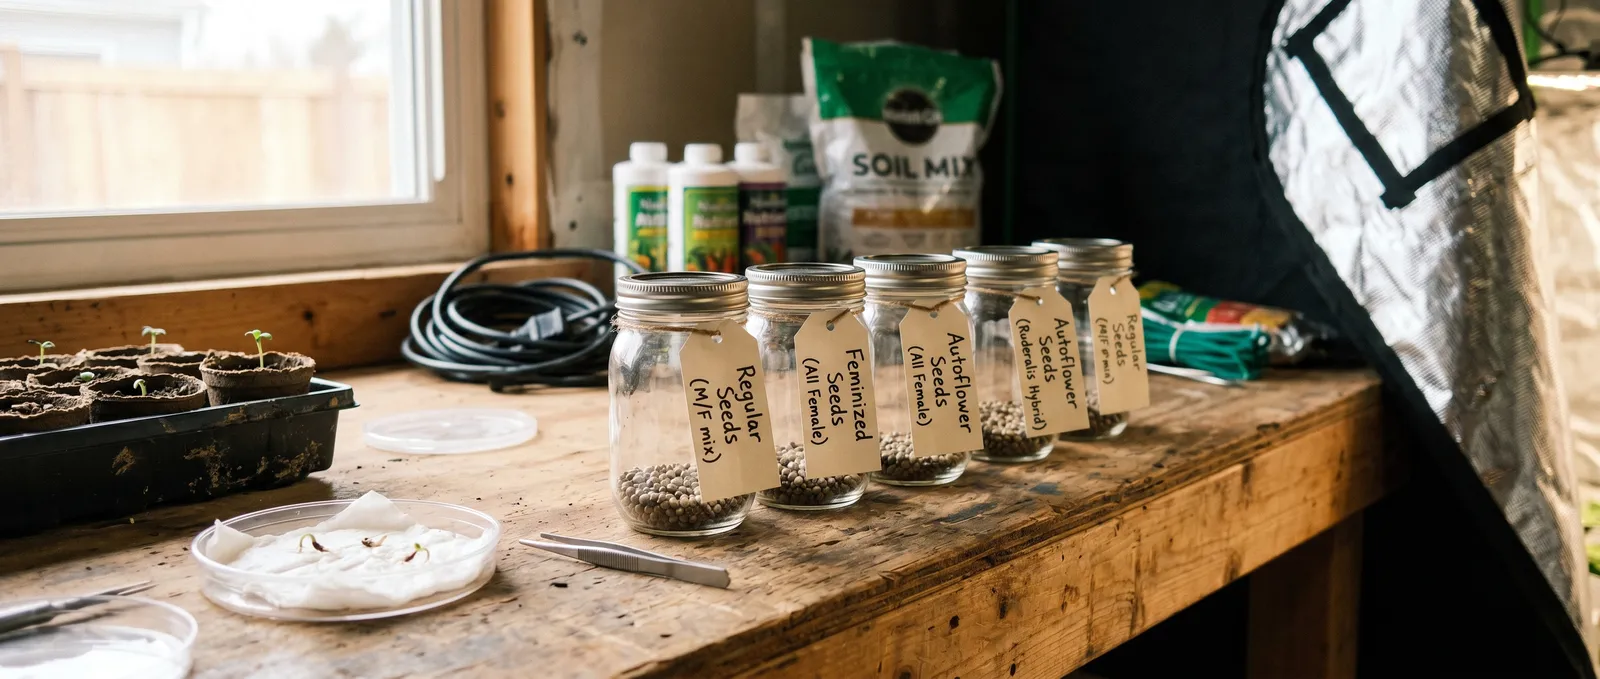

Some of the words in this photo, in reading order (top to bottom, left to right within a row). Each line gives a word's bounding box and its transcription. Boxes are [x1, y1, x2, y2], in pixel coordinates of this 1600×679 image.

[853, 153, 917, 179] SOIL
[924, 157, 976, 178] MIX
[907, 345, 924, 368] (All
[1016, 318, 1038, 380] (Ruderalis
[1039, 335, 1058, 383] Seeds
[1054, 318, 1077, 410] Autoflower
[1112, 323, 1128, 368] Seeds
[1125, 313, 1142, 371] Regular
[802, 358, 820, 384] (All
[846, 348, 873, 442] Feminized
[930, 356, 951, 408] Seeds
[947, 332, 971, 433] Autoflower
[690, 378, 713, 421] (M/F
[717, 386, 741, 445] Seeds
[735, 365, 763, 443] Regular
[807, 389, 829, 446] Female)
[827, 372, 848, 427] Seeds
[913, 374, 933, 426] Female)
[1025, 385, 1047, 431] Hybrid)
[700, 426, 722, 463] mix)
